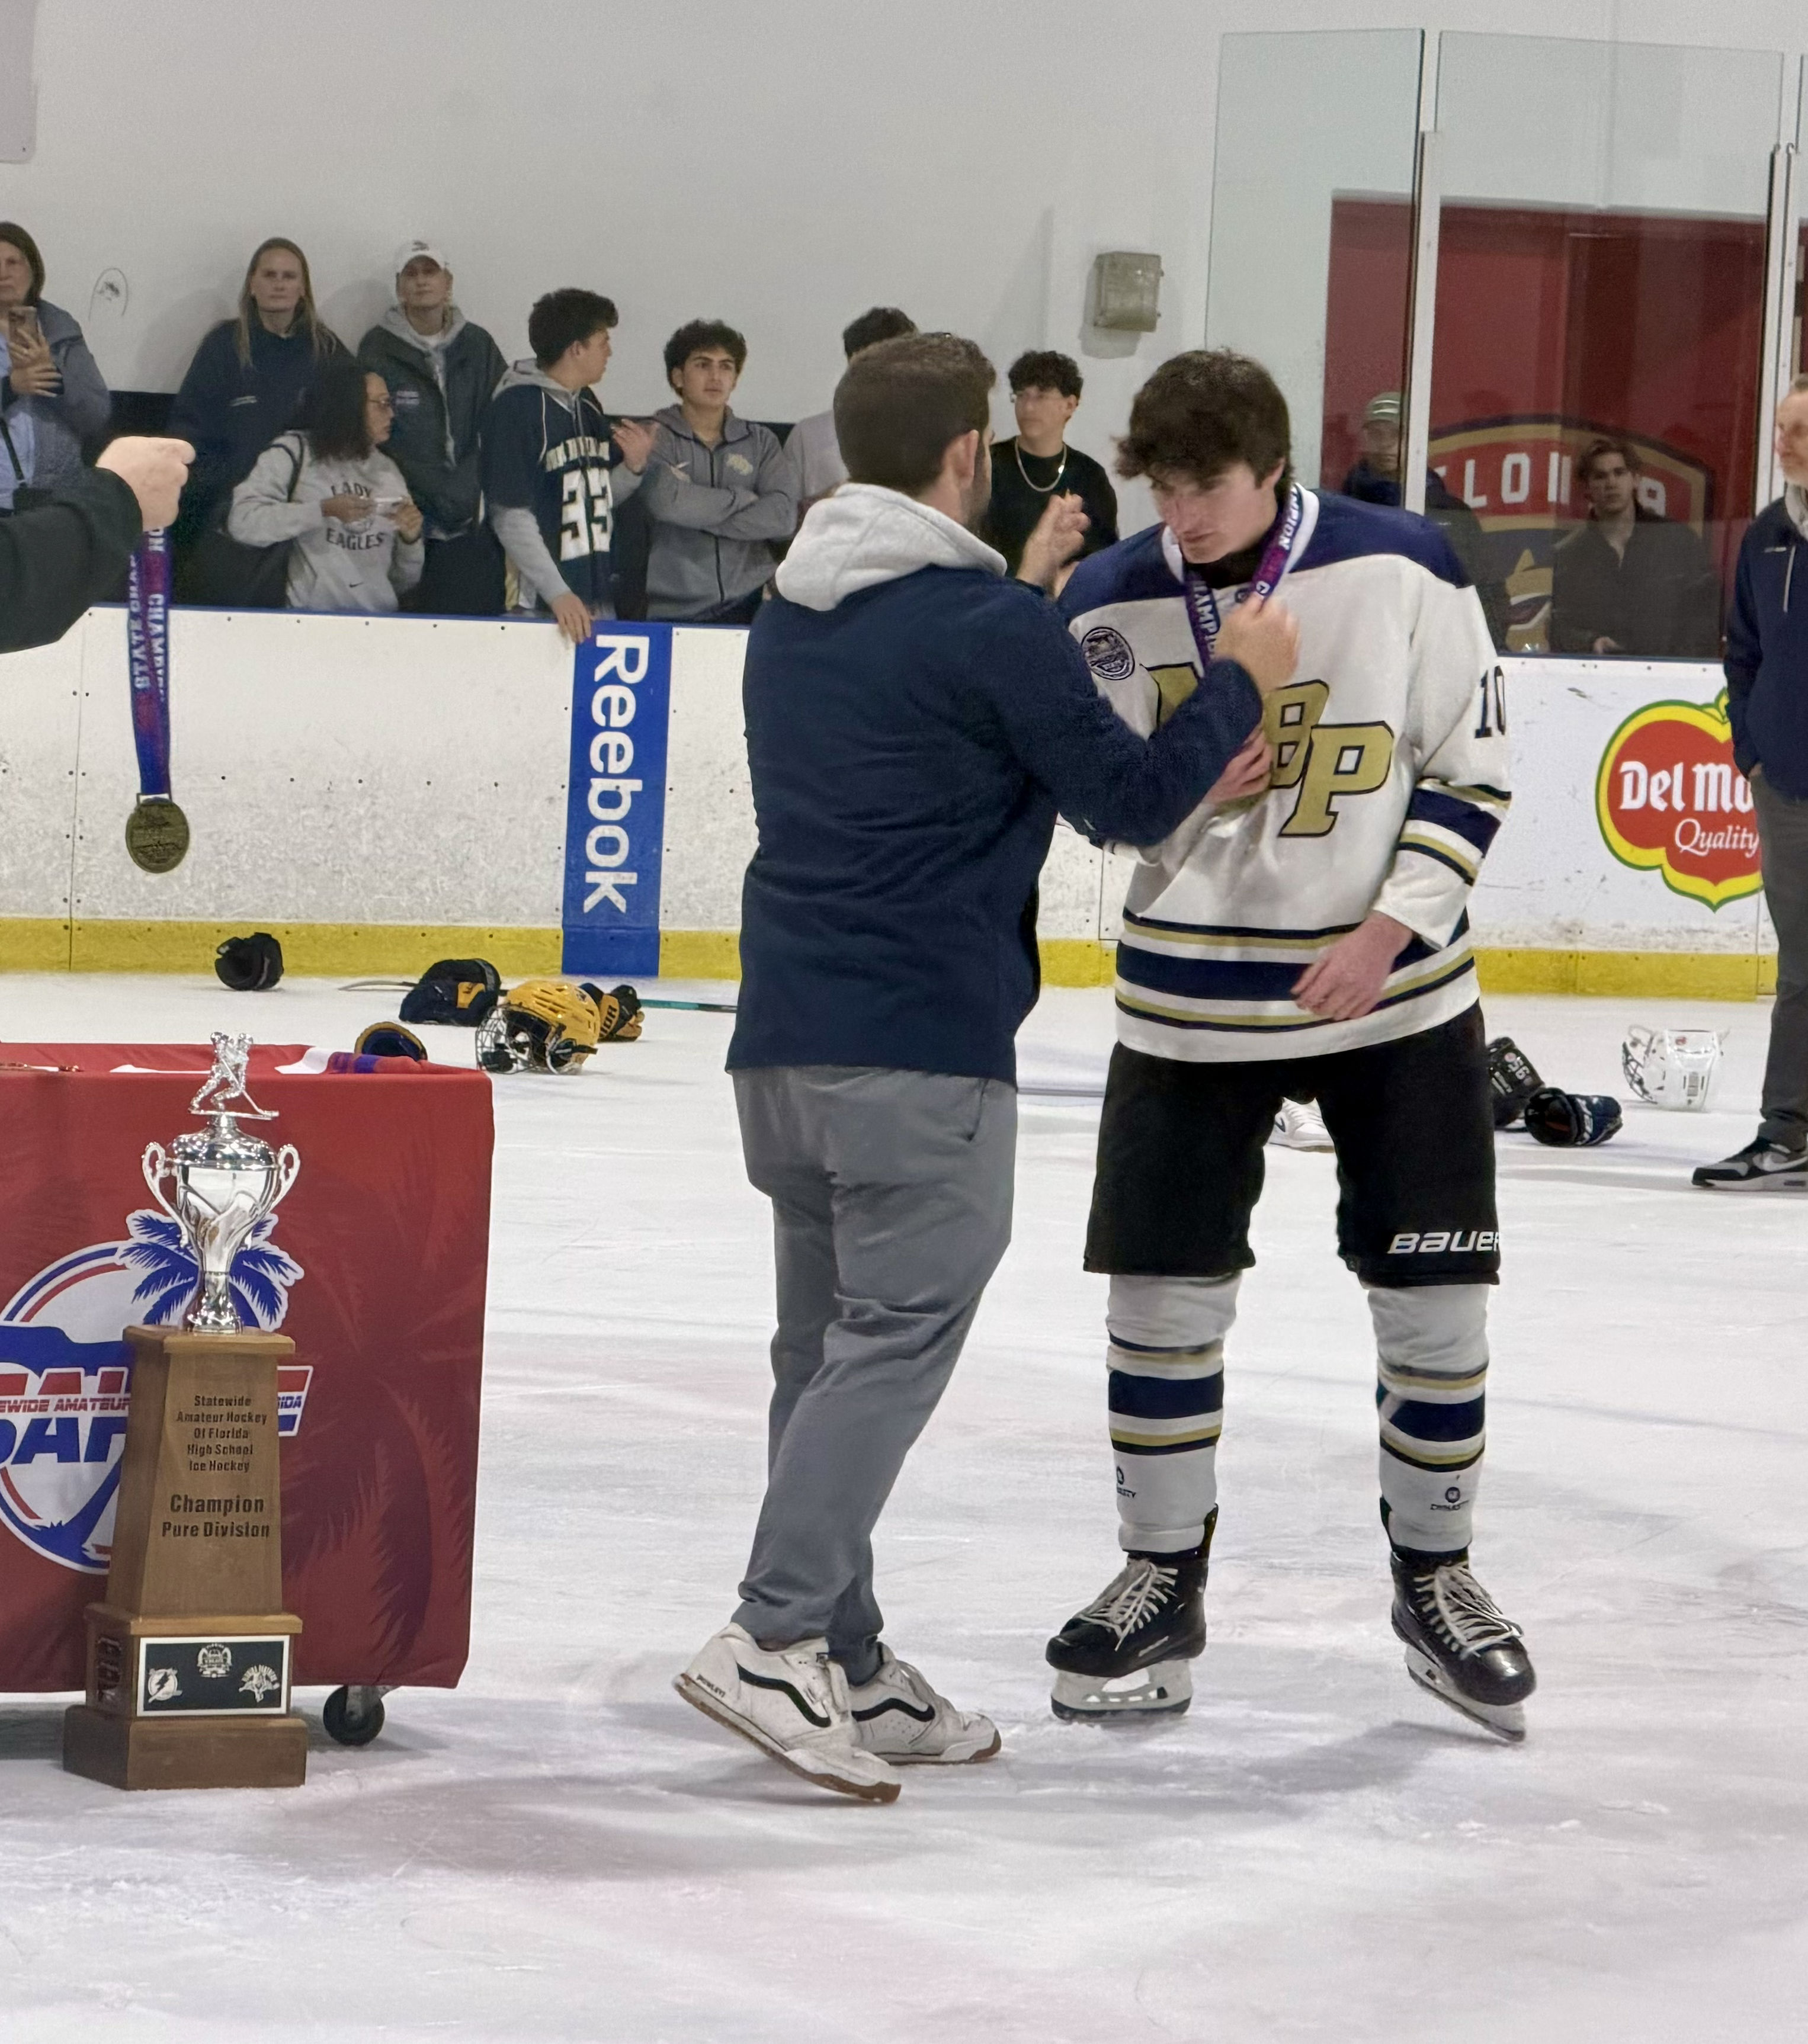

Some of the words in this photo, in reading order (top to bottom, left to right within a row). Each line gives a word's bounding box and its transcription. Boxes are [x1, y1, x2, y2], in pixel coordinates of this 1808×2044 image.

[560, 467, 613, 560] 33
[326, 528, 384, 550] EAGLES
[1474, 665, 1506, 739] 10
[583, 634, 650, 914] Reebok
[1619, 761, 1685, 812] Del
[1674, 817, 1760, 858] Quality
[194, 1395, 252, 1407] Statewide
[177, 1411, 223, 1423] Amateur
[226, 1411, 267, 1425] Hockey
[209, 1427, 249, 1439] Florida
[187, 1443, 212, 1457] High
[215, 1444, 254, 1455] School
[190, 1460, 206, 1471] Ice
[209, 1459, 250, 1474] Hockey
[170, 1494, 264, 1517] Champion
[162, 1522, 199, 1538] Pure
[203, 1521, 270, 1538] Division
